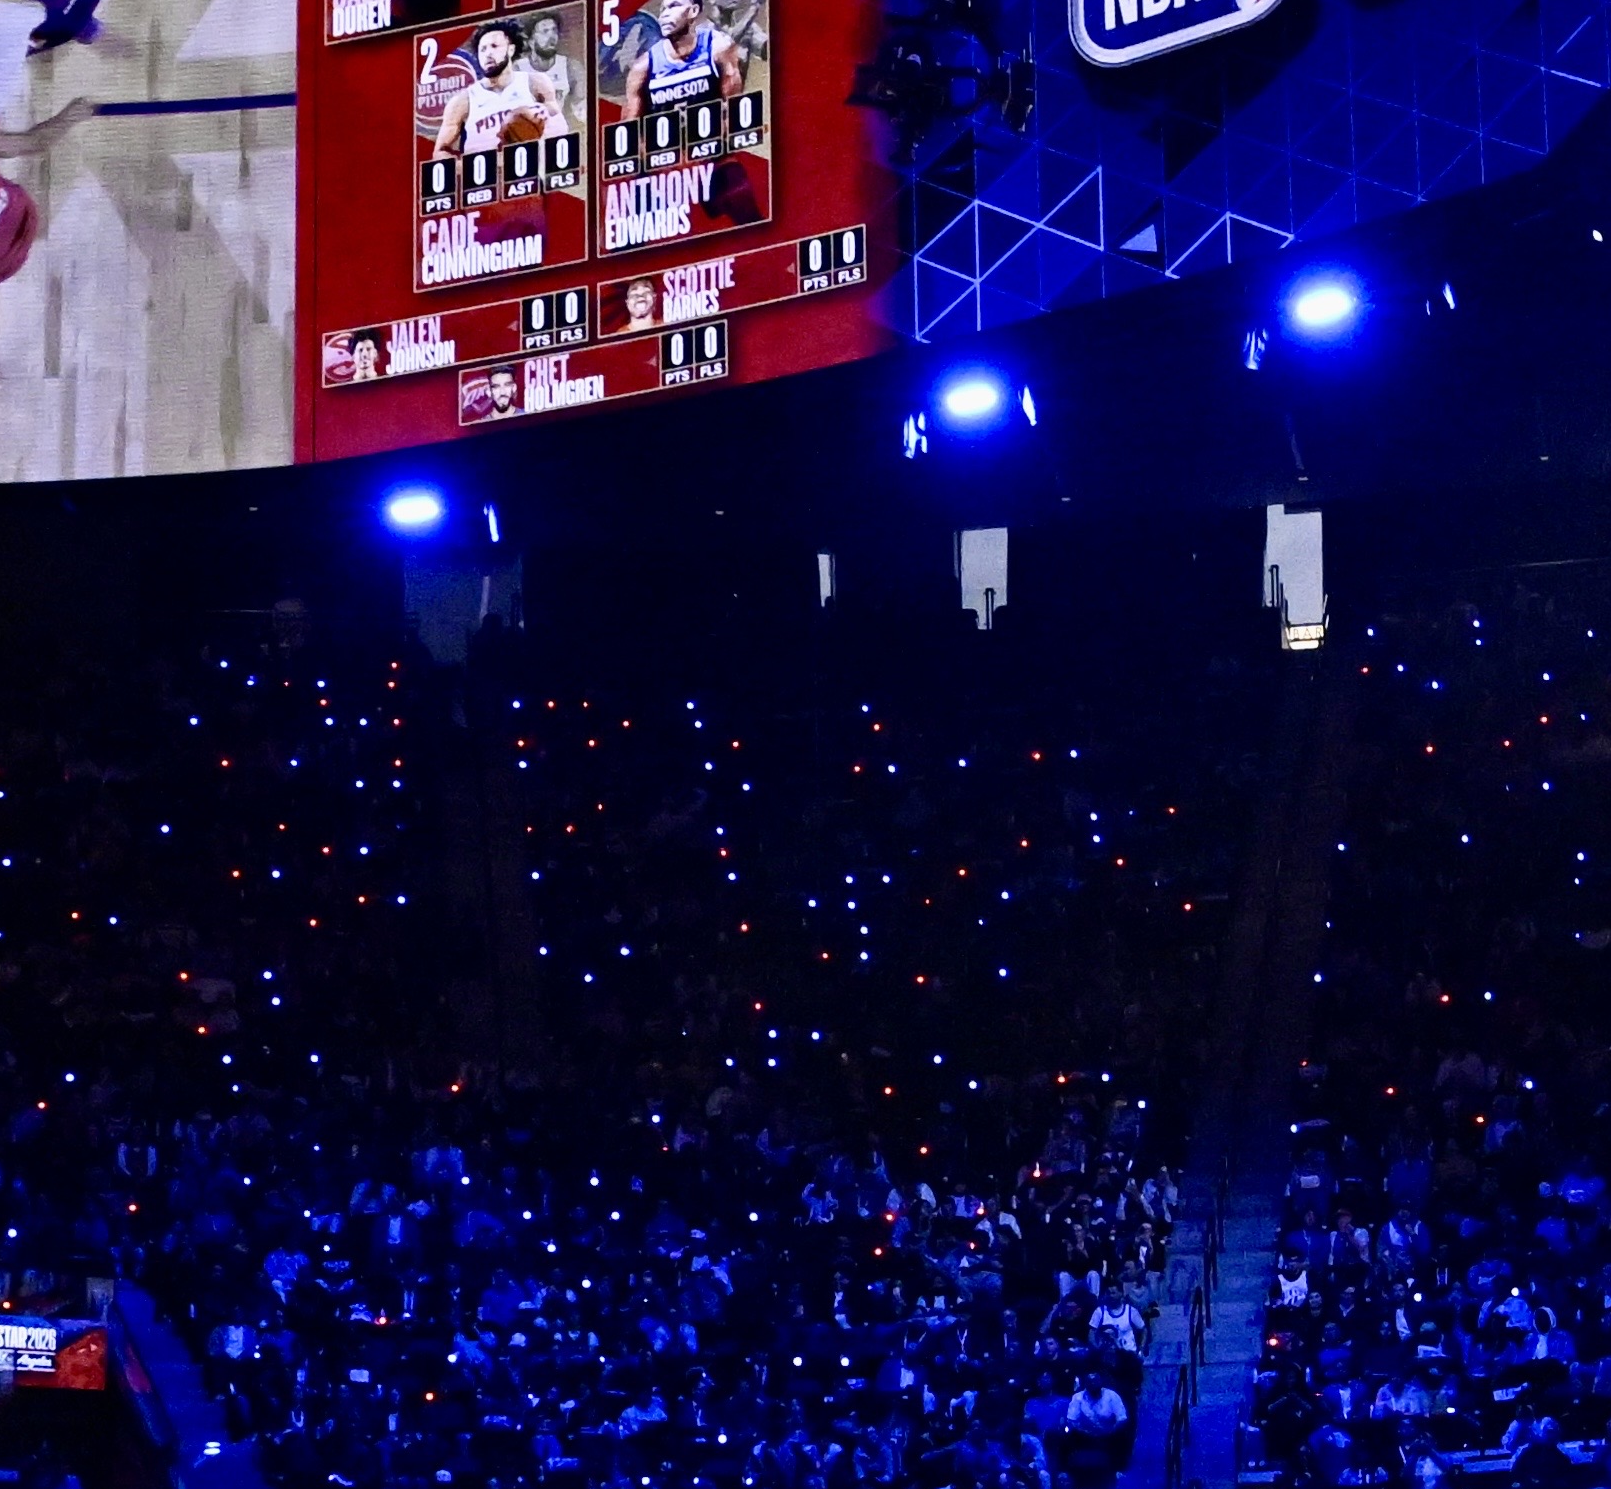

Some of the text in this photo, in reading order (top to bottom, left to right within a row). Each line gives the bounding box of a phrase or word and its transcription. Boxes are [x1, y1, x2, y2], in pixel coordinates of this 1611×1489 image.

[332, 0, 391, 37] DUREN
[602, 0, 620, 48] 5
[419, 38, 438, 84] 2
[605, 163, 714, 220] ANTHONY
[422, 211, 481, 257] CADE
[605, 204, 691, 250] EDWARDS
[421, 234, 542, 285] CUNNINGHAM
[662, 258, 736, 298] SCOTTIE
[662, 288, 720, 324] BARNES
[387, 316, 441, 354] JALEN
[385, 340, 455, 375] JOHNSON
[524, 355, 569, 389] CHET
[524, 375, 604, 413] HOLMGREN
[28, 1328, 56, 1350] 2026
